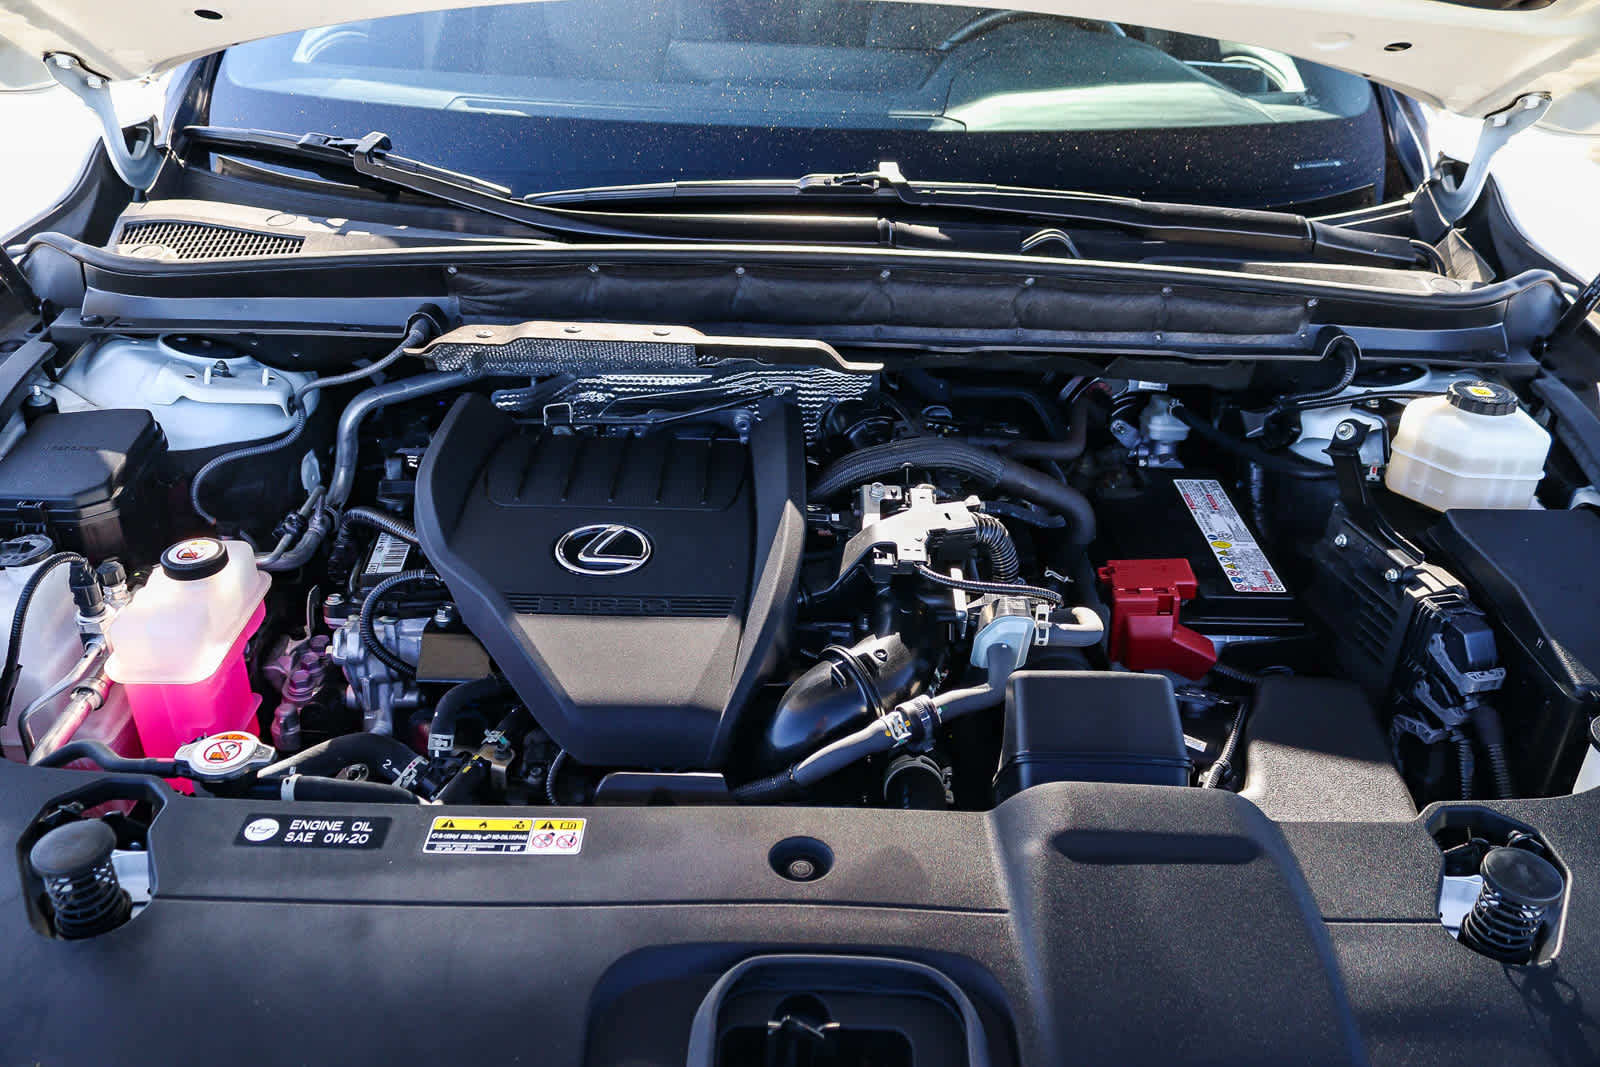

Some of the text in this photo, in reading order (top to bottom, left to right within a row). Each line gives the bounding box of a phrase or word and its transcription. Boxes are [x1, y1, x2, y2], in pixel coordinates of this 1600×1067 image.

[289, 819, 374, 832] ENGINE OIL
[284, 832, 369, 844] SAE 0W-20
